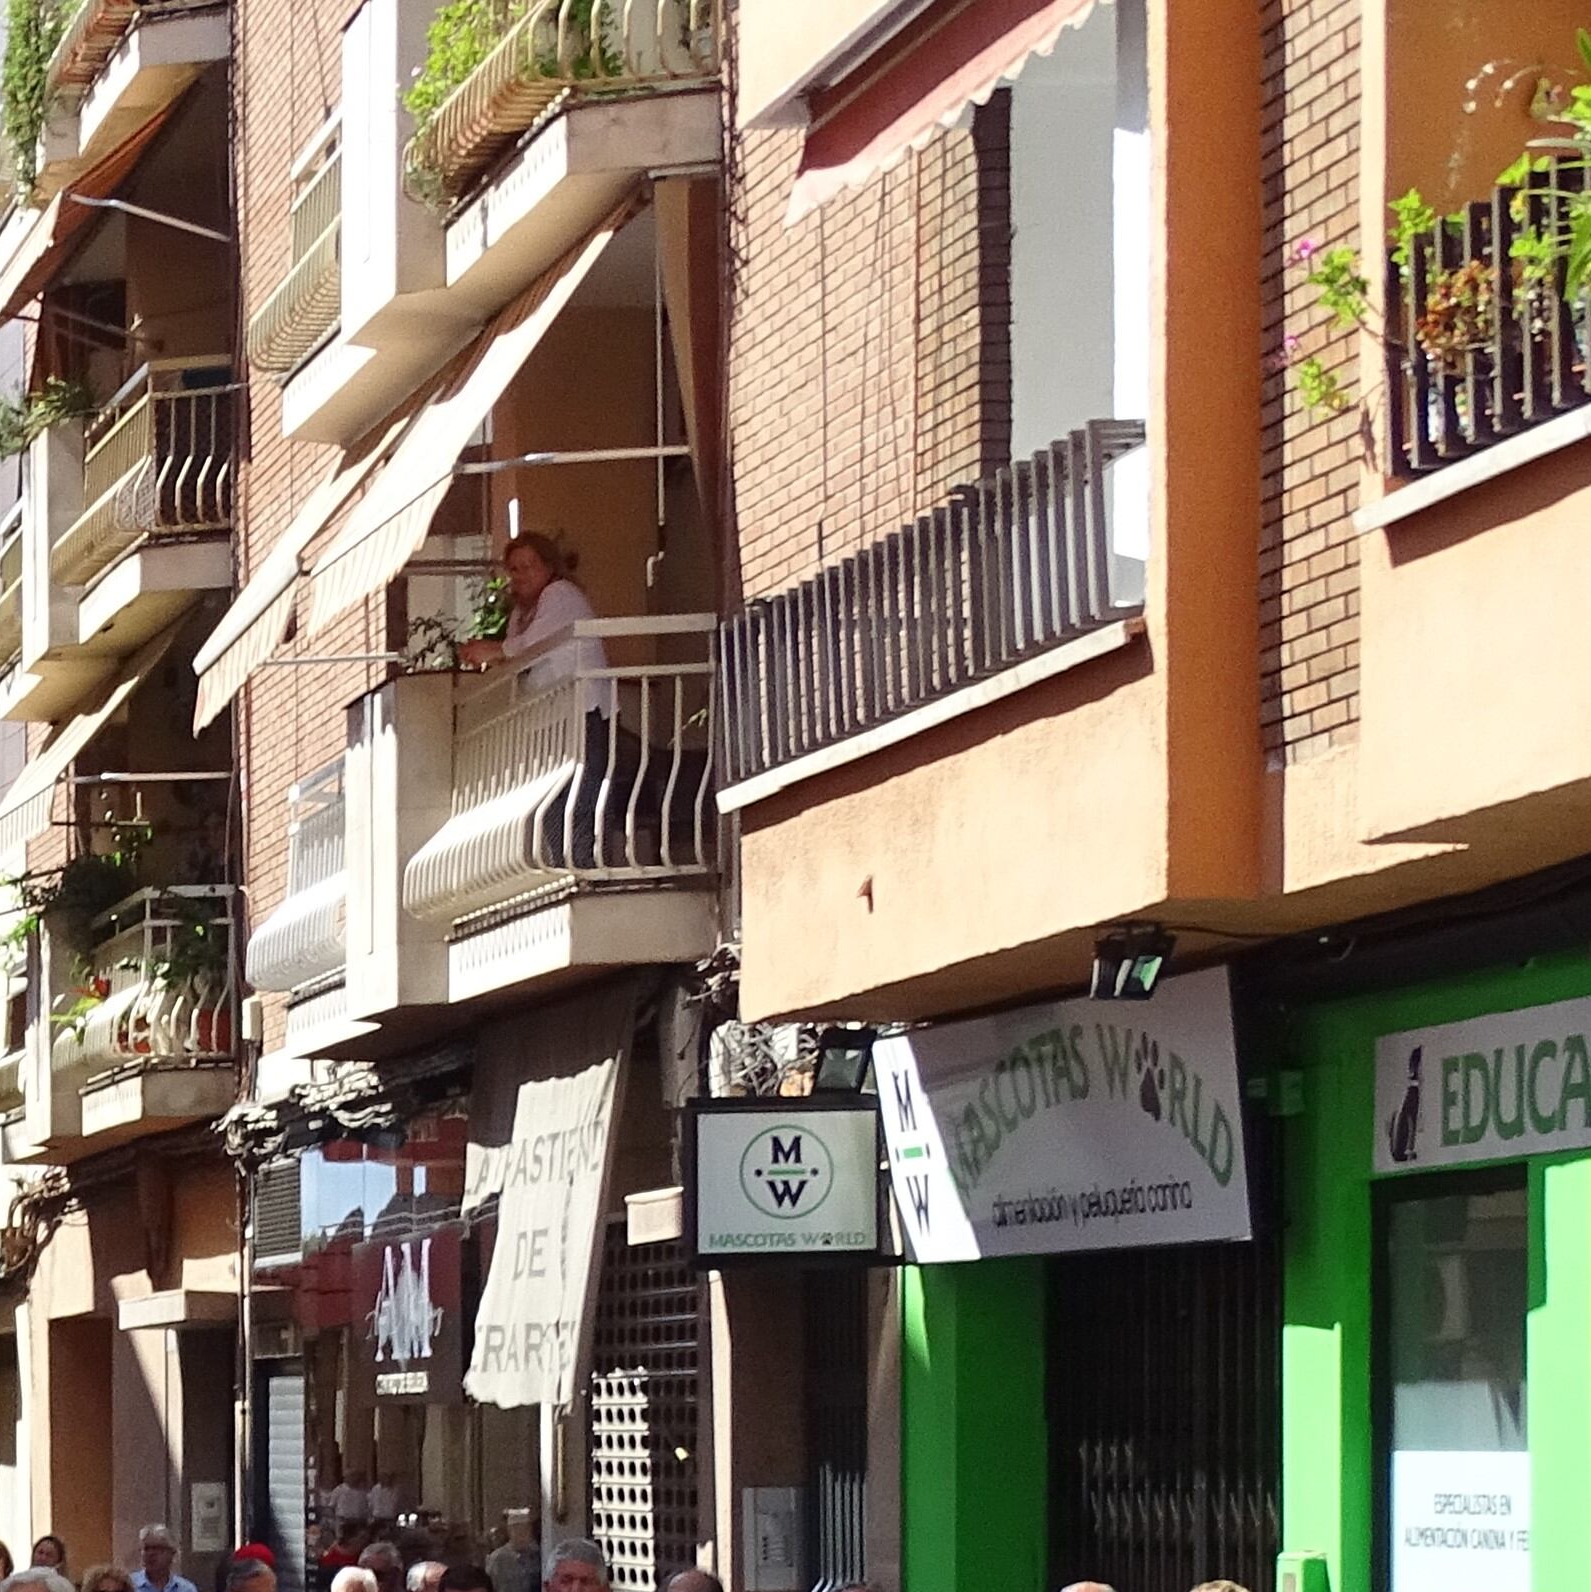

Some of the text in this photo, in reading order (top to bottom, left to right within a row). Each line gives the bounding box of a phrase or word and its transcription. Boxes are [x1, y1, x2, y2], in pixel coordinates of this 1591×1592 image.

[771, 1135, 803, 1164] M
[766, 1179, 808, 1208] W
[512, 1228, 549, 1281] DE
[709, 1232, 796, 1248] MASCOTAS
